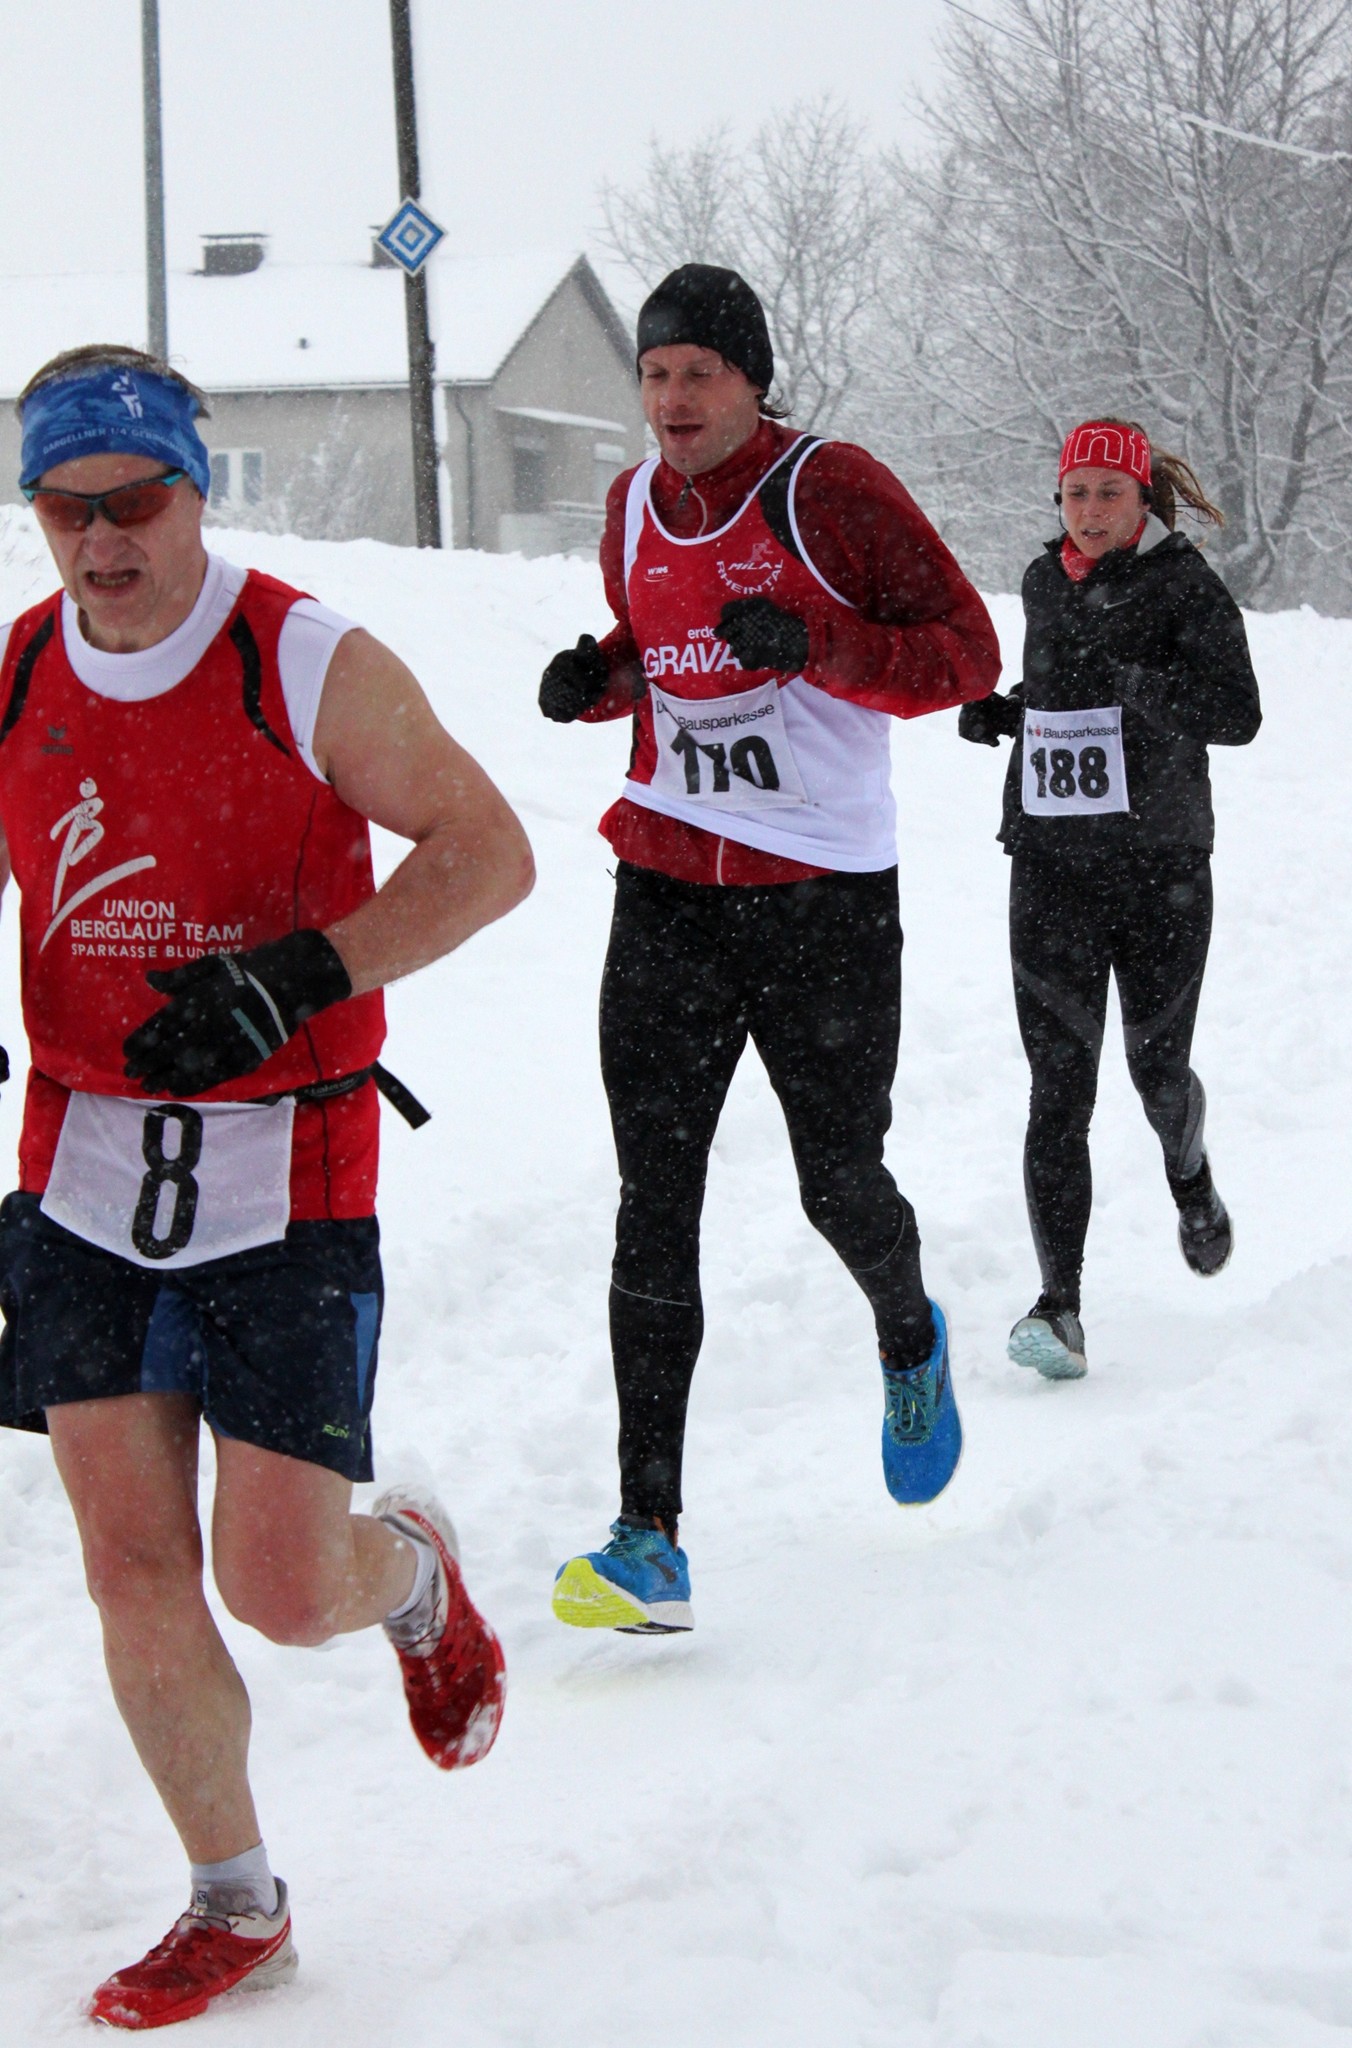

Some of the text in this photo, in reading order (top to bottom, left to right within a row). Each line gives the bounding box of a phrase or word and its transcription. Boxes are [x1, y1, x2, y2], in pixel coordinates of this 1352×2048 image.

[716, 559, 784, 595] RHEINTAL
[678, 704, 775, 731] Bausparkasse
[1043, 726, 1119, 740] Bausparkasse
[1029, 746, 1110, 799] 188
[103, 899, 176, 919] UNION
[70, 919, 243, 943] BERGLAUF TEAM
[71, 943, 157, 959] SPARKASSE
[131, 1102, 204, 1260] 8
